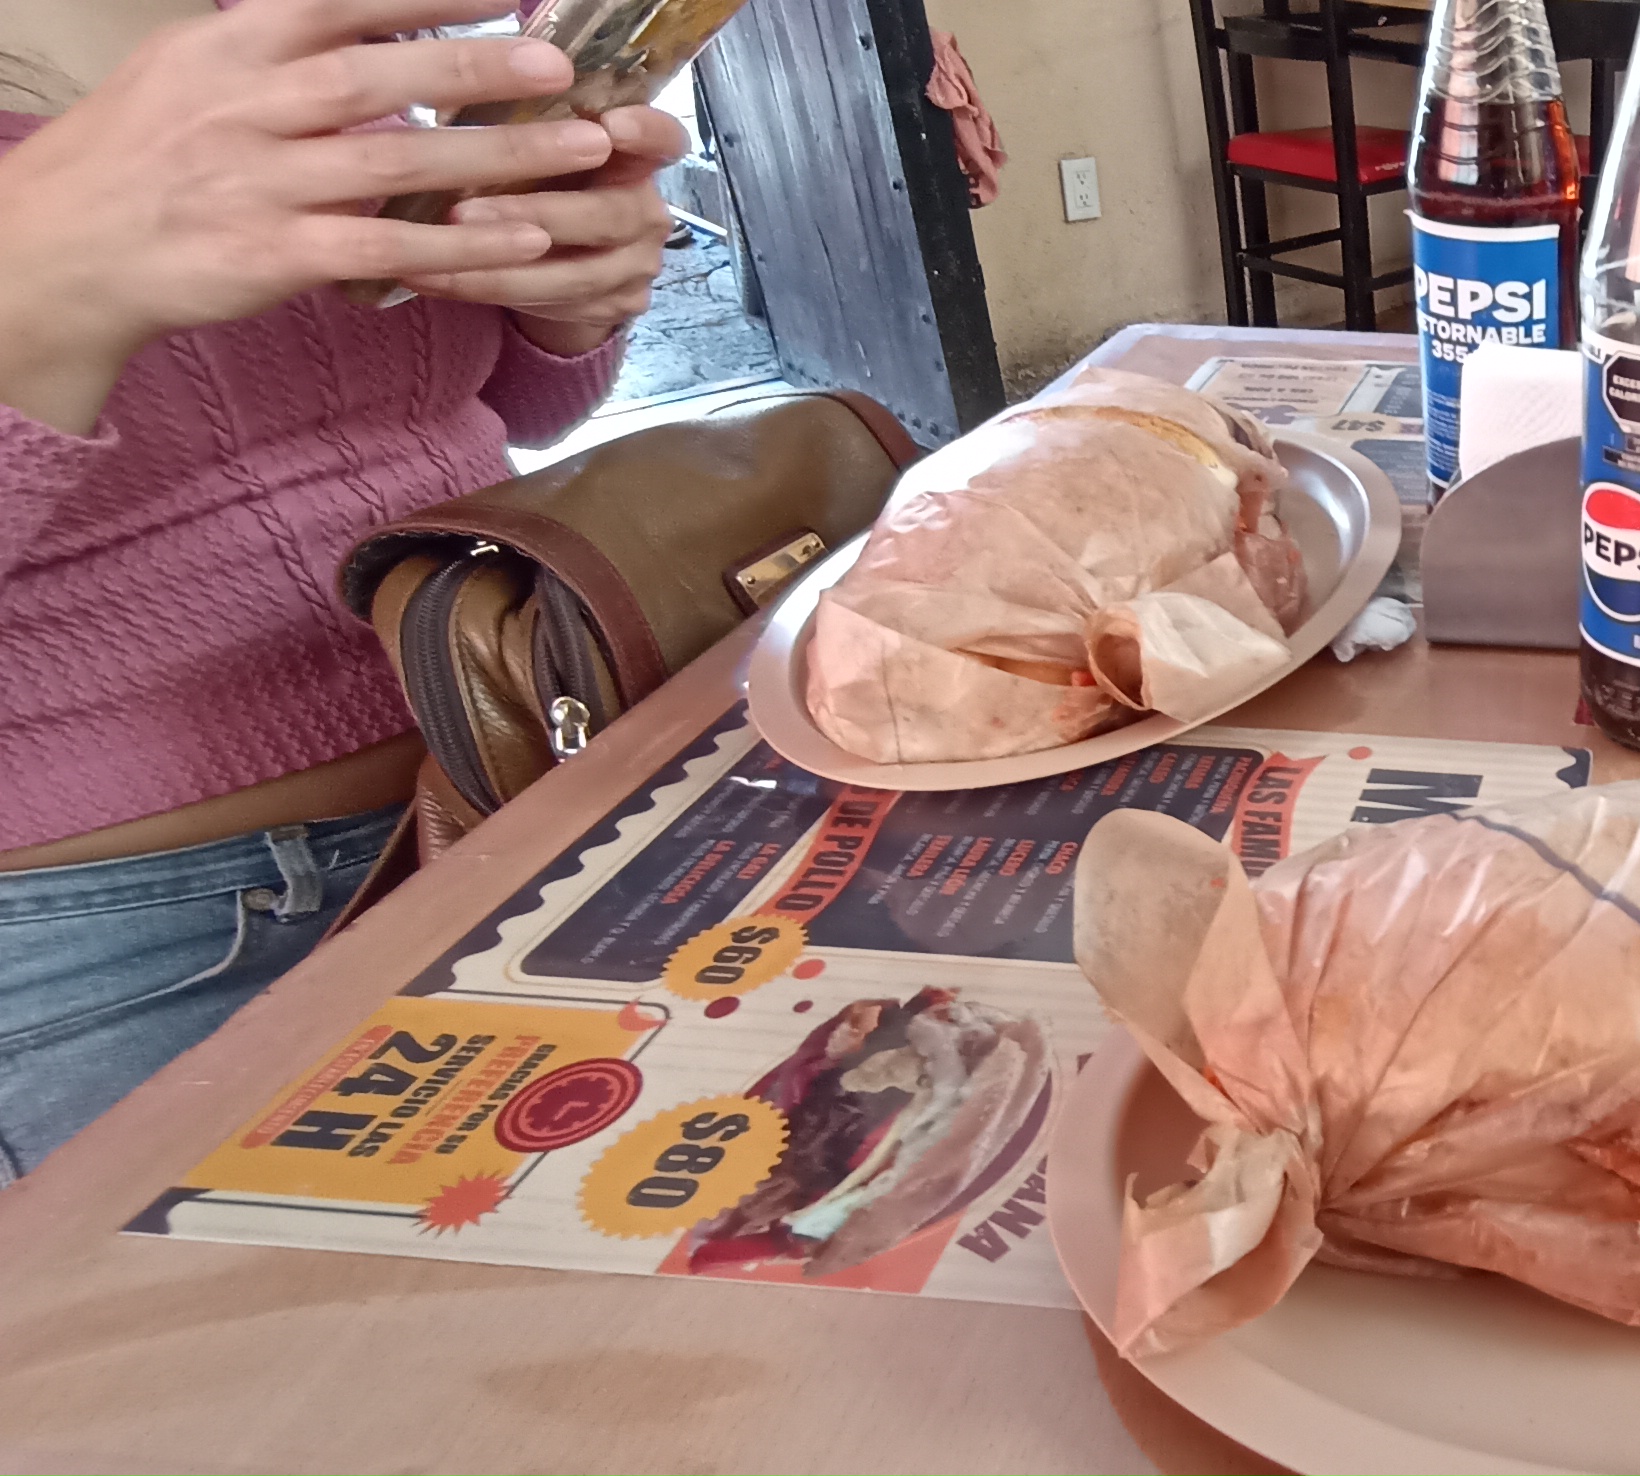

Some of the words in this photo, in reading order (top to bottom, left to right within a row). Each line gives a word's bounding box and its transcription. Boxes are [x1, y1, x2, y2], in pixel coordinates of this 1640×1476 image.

[1414, 263, 1546, 322] PEPSI
[1417, 308, 1546, 345] ETORNABLE
[1247, 766, 1303, 804] LAS
[831, 801, 878, 828] DE
[775, 835, 864, 910] POLLO
[694, 926, 780, 984] $60
[330, 1030, 458, 1096] 24
[389, 1034, 498, 1118] SERVICIO
[487, 1044, 557, 1101] GRACIAS
[386, 1035, 541, 1164] PREFERENCIA
[456, 1104, 498, 1131] POR
[270, 1110, 378, 1150] H
[347, 1122, 405, 1157] LAS
[435, 1135, 467, 1154] SU
[625, 1111, 750, 1208] $80
